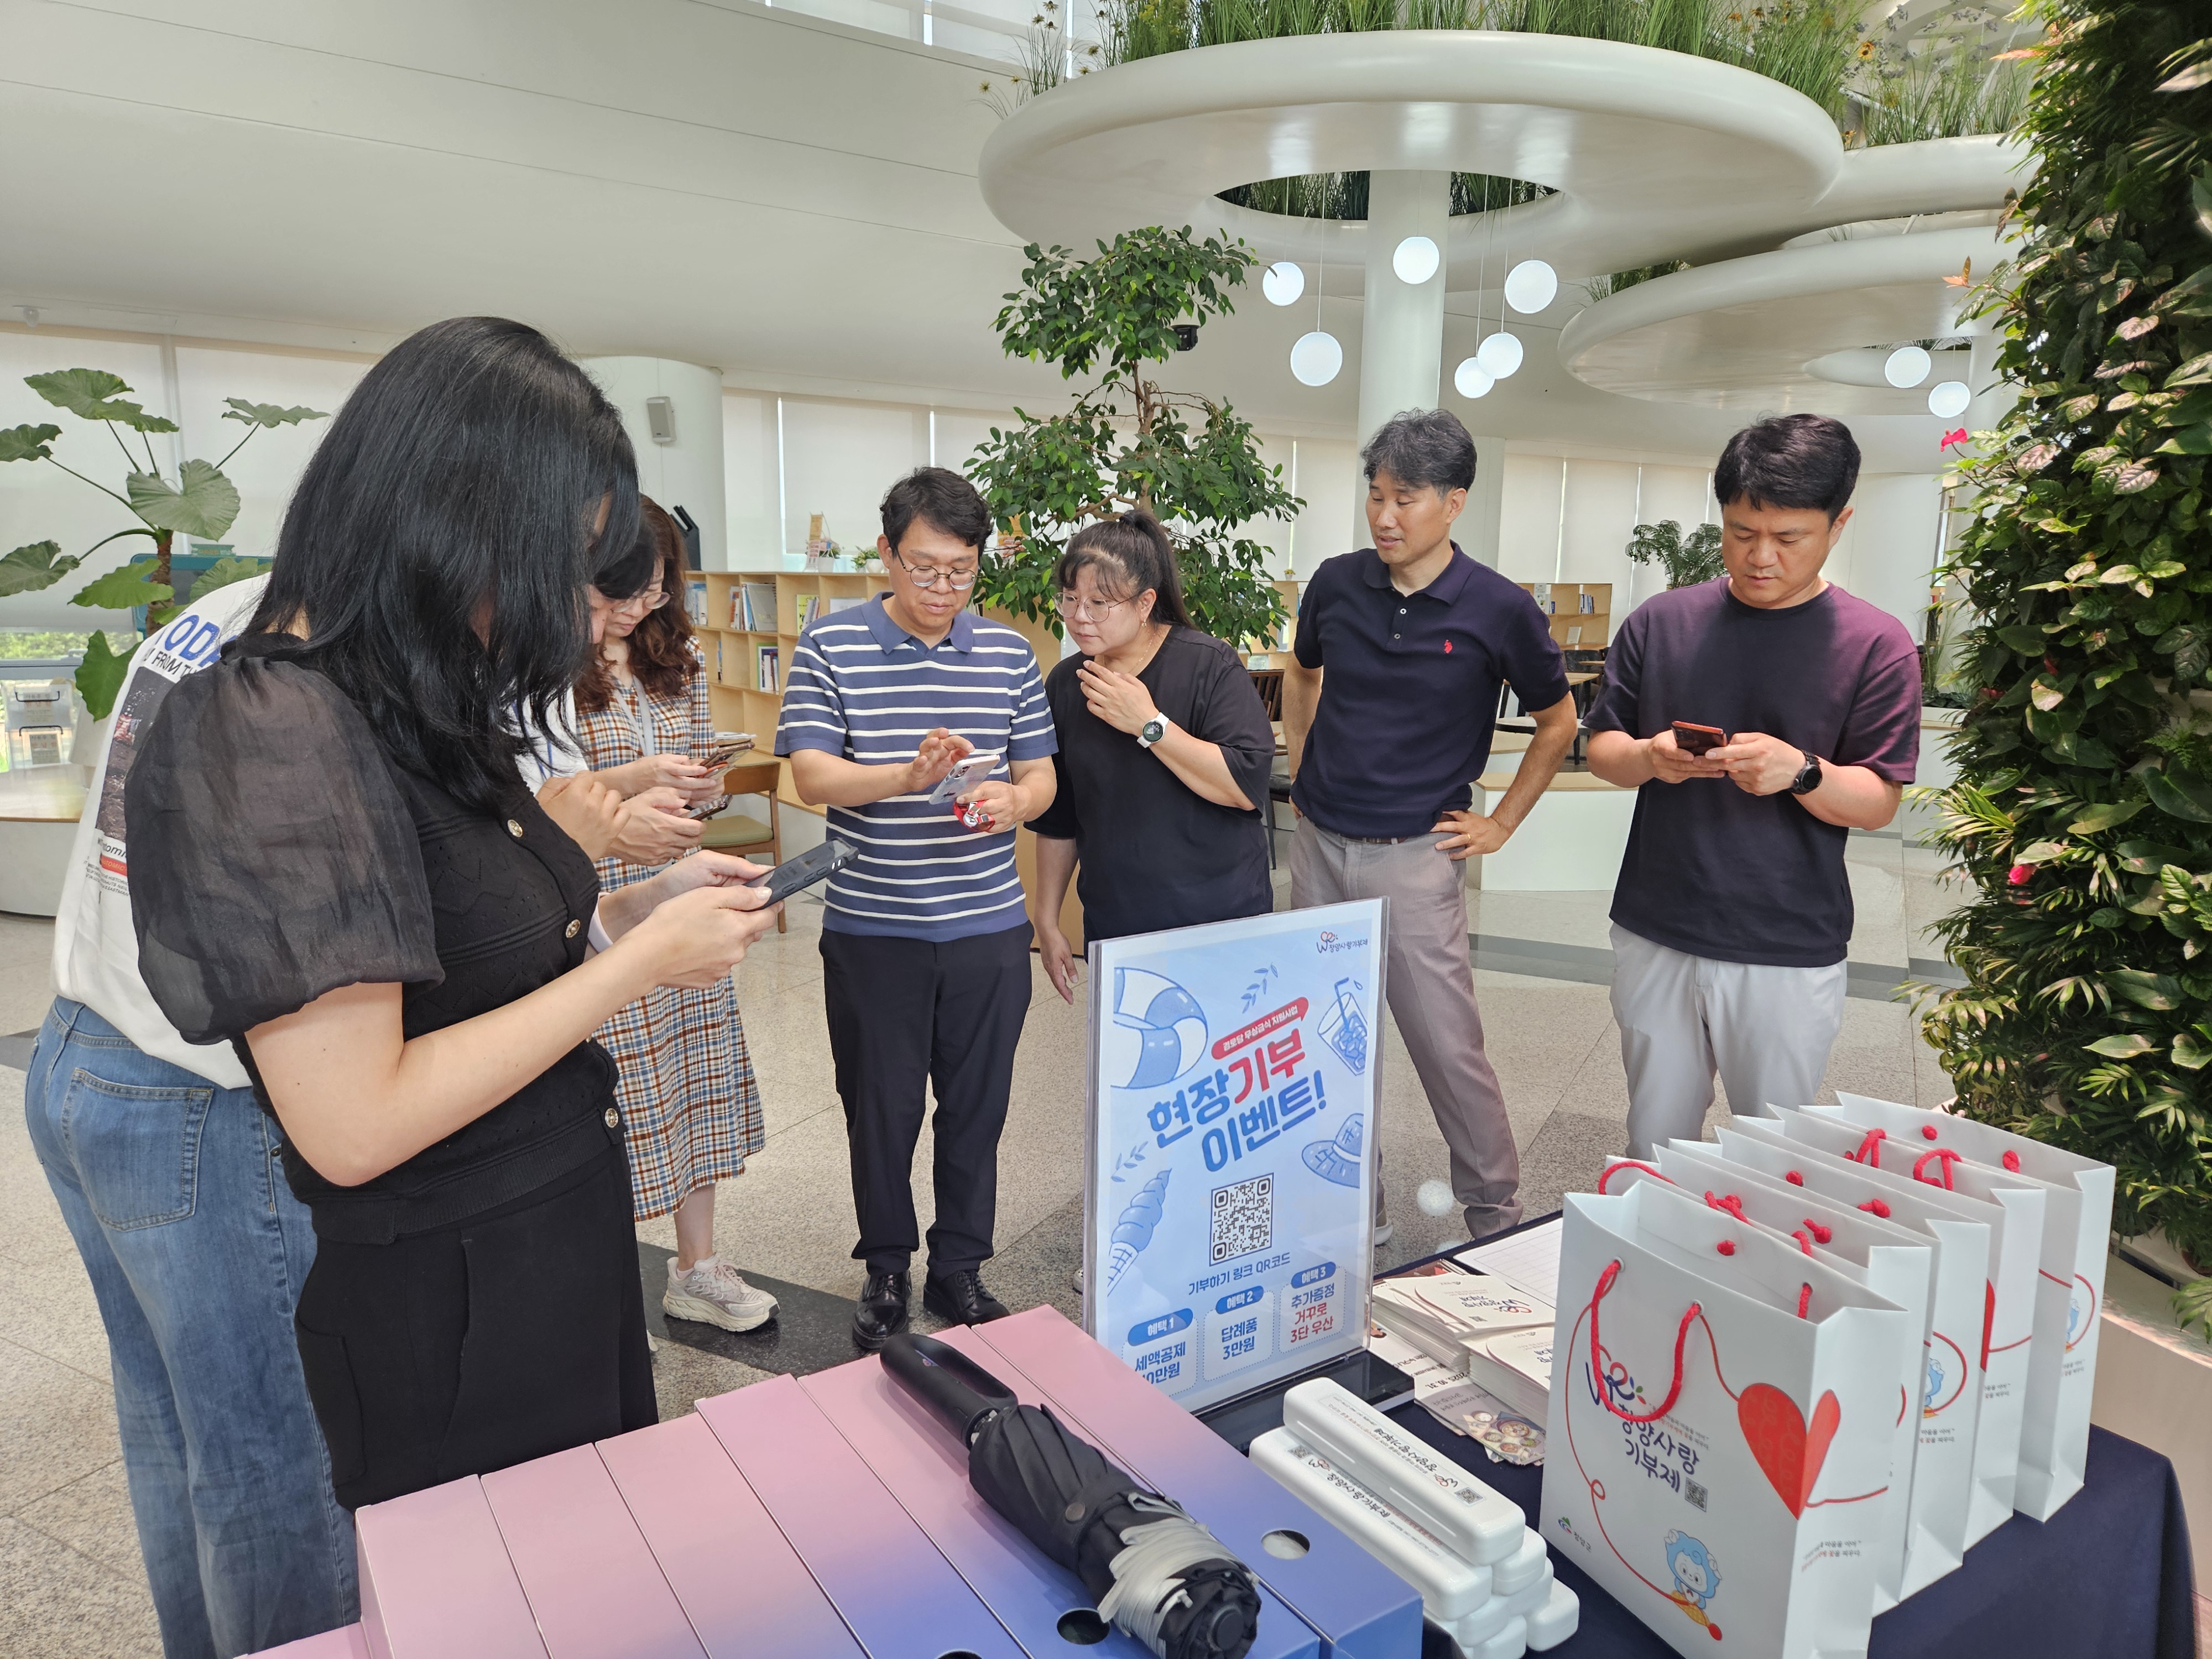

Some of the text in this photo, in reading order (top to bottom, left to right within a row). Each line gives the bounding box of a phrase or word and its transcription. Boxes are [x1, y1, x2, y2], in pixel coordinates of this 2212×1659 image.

[152, 651, 183, 675] FROM
[1223, 1005, 1298, 1051] 경로당 무상급식 지원사업
[1202, 1070, 1327, 1172] 이벤트!
[1188, 1252, 1291, 1296] 기부하기 링크 QR코드
[1301, 1266, 1326, 1285] 혜택 3
[1226, 1290, 1254, 1310] 혜택 2
[1291, 1282, 1335, 1309] 추가증정
[1295, 1302, 1327, 1325] 거꾸로
[1147, 1317, 1175, 1337] 혜택 1
[1221, 1317, 1258, 1343] 답례품
[1290, 1316, 1334, 1343] 3단 우산
[1134, 1341, 1186, 1373] 세액공제
[1223, 1335, 1255, 1360] 3만원
[1625, 1438, 1681, 1494] 기부제
